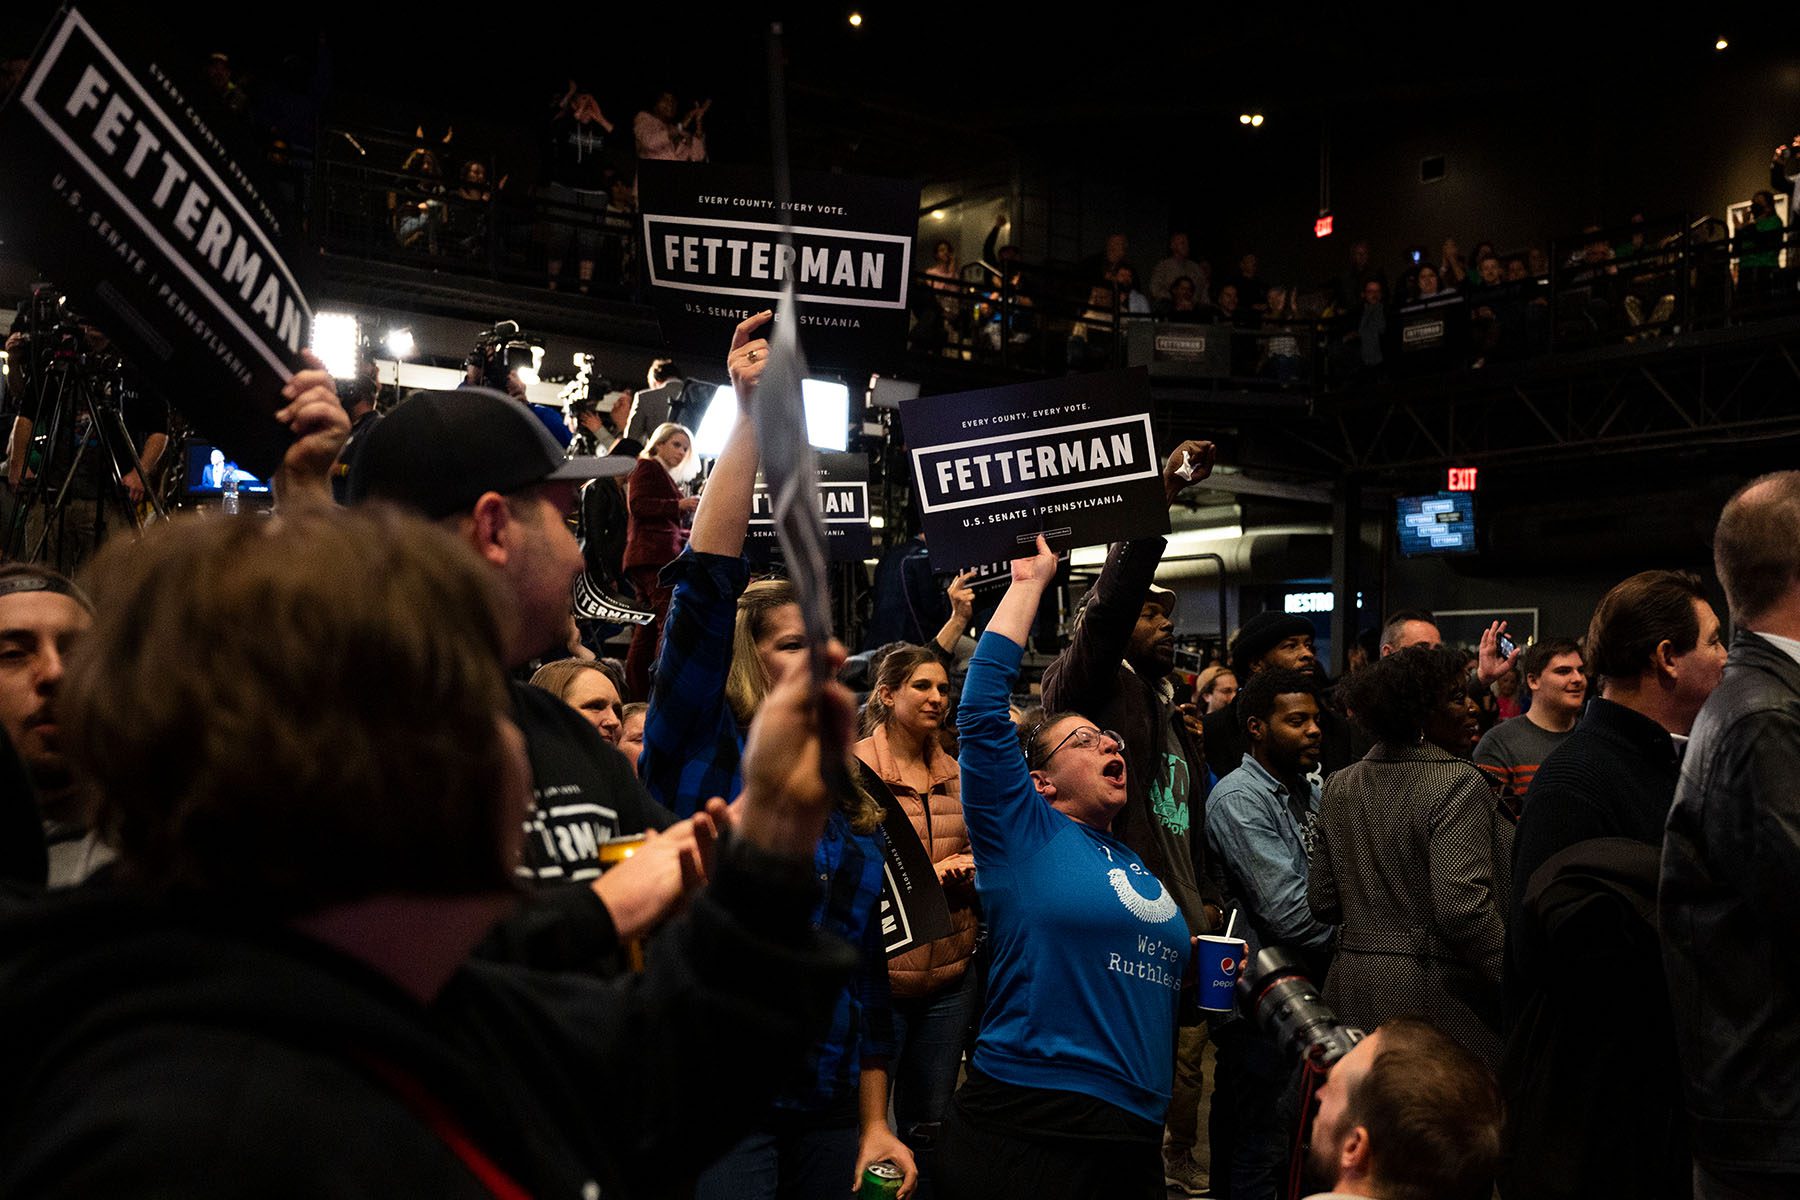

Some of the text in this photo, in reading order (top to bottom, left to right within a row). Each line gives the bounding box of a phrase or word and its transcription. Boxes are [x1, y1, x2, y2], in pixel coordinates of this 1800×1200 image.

[64, 63, 302, 355] FETTERMAN
[698, 194, 848, 216] EVERY COUNTY. EVERY VOTE.
[664, 234, 885, 289] FETTERMAN
[87, 210, 147, 276] SENATE
[157, 282, 253, 387] PENNSYLVANIA
[685, 302, 705, 314] U.S.
[708, 306, 749, 320] SENATE
[961, 402, 1091, 429] EVERY COUNTY. EVERY VOTE.
[935, 432, 1135, 495] FETTERMAN
[1448, 467, 1478, 491] EXIT
[963, 517, 985, 528] U.S.
[988, 509, 1028, 524] SENATE
[1040, 494, 1124, 516] PENNSYLVANIA
[1138, 934, 1178, 963] We're
[1107, 952, 1182, 992] Ruthless
